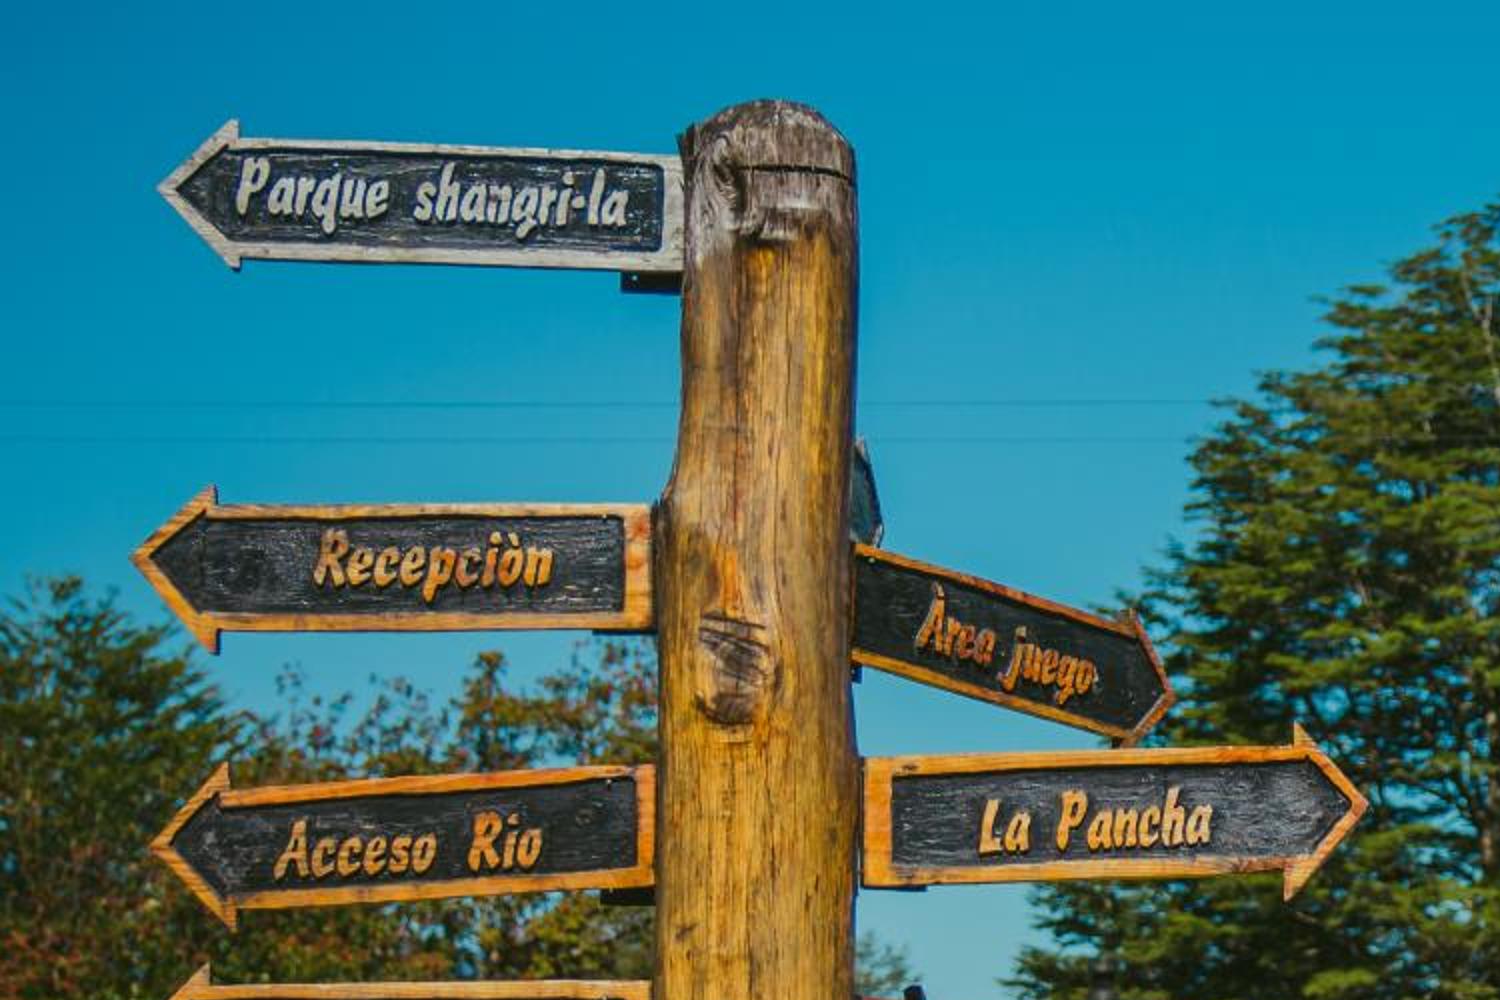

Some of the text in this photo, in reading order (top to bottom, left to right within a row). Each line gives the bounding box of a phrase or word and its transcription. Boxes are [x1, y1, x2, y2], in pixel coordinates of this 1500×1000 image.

[236, 157, 630, 239] Parque shangri-la
[998, 625, 1097, 704] juego
[274, 820, 438, 881] Acceso
[978, 786, 1213, 854] La Pancha
